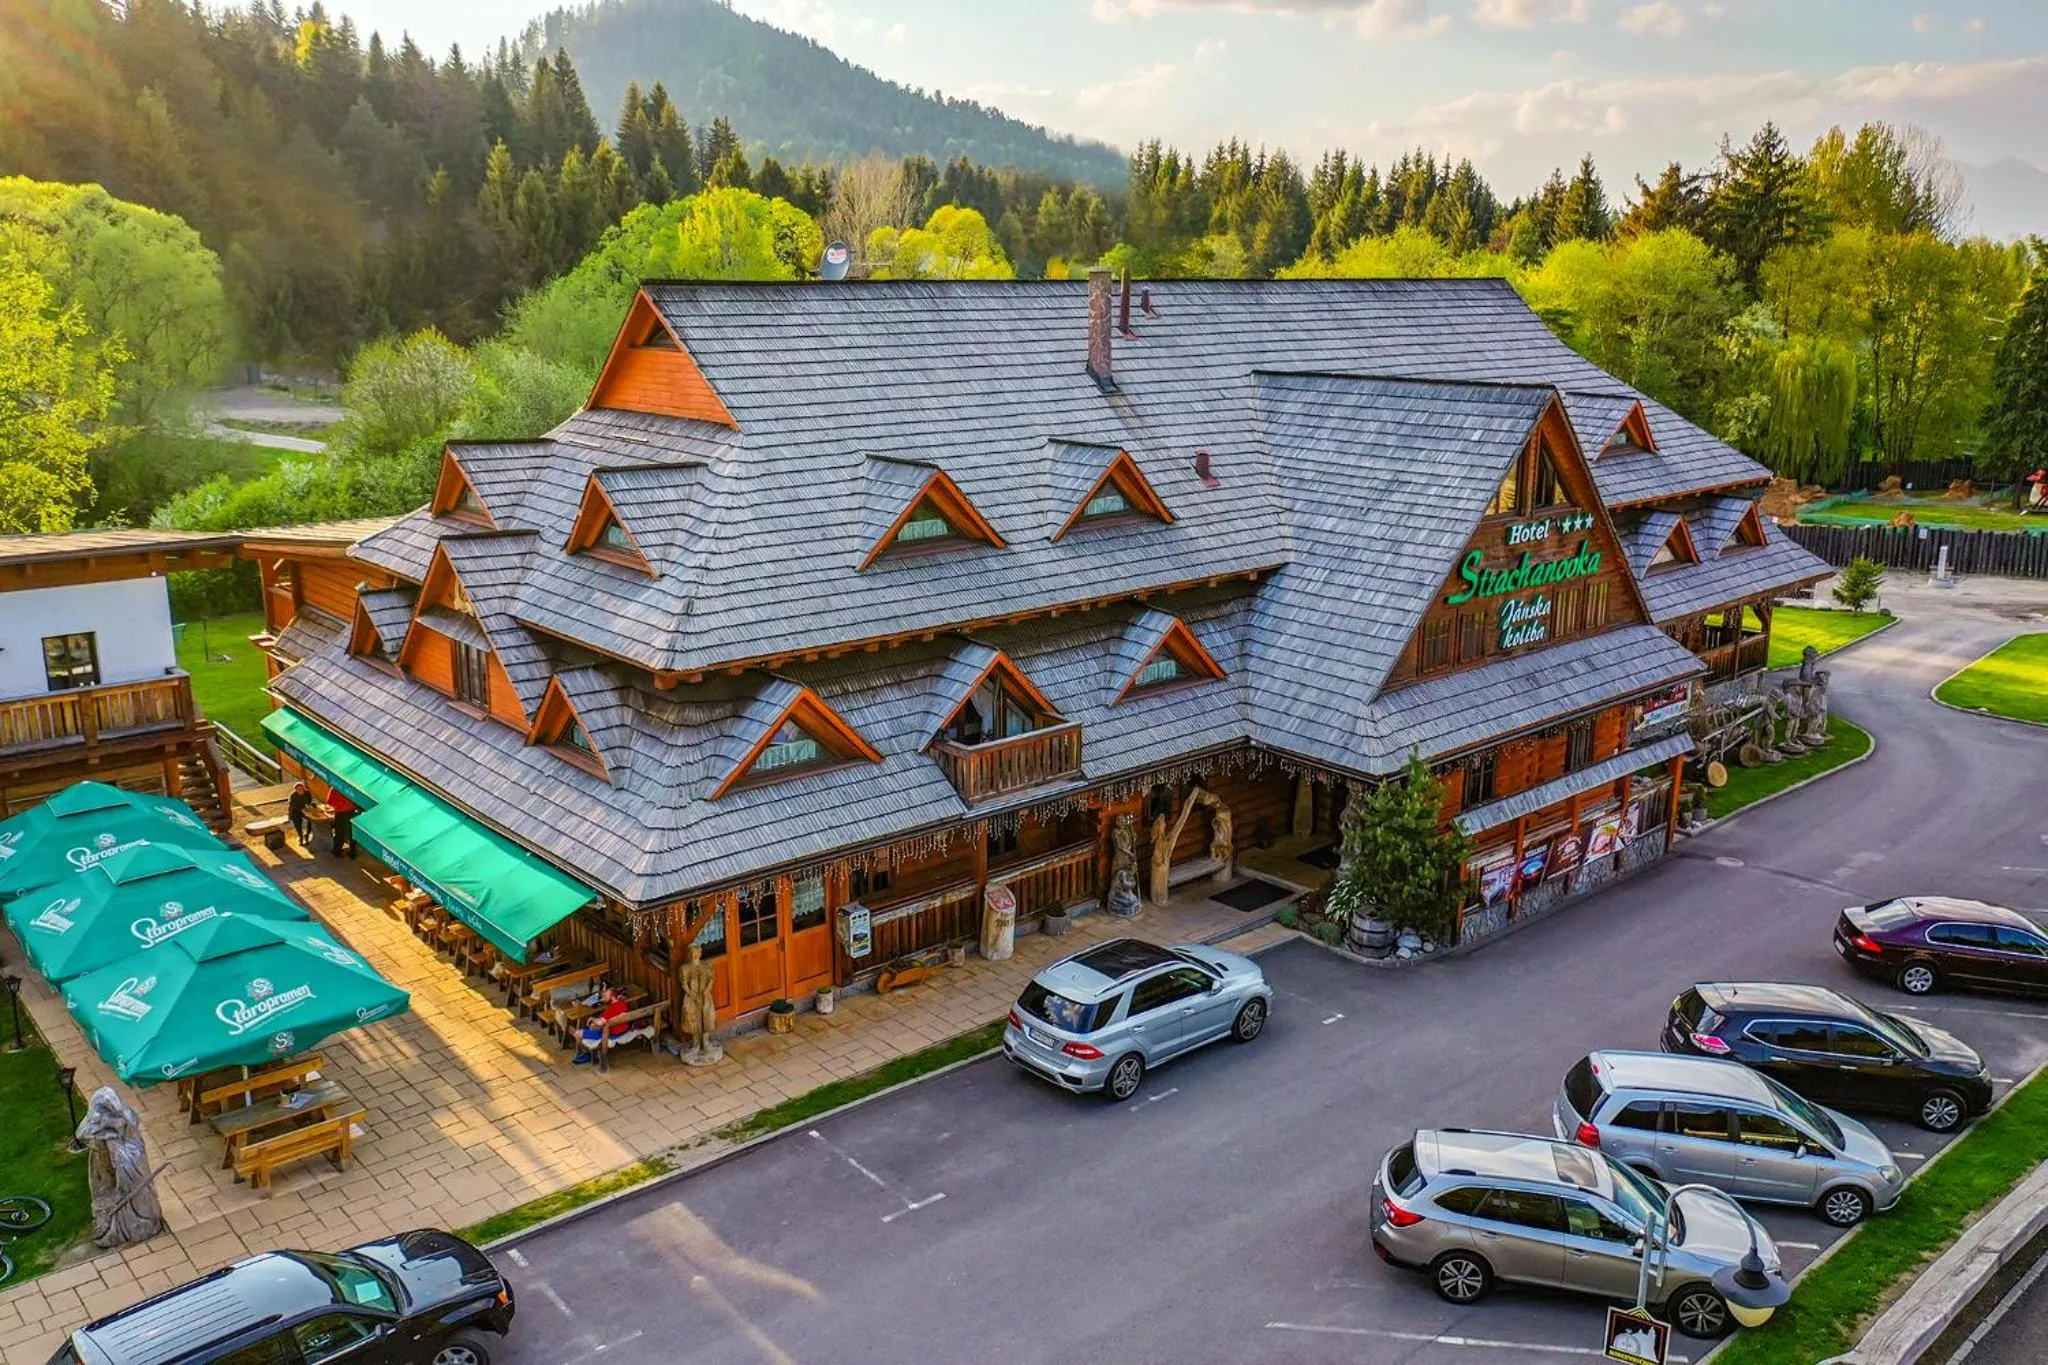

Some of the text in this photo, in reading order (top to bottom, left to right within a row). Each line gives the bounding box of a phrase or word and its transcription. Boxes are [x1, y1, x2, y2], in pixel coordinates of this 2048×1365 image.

[1509, 520, 1550, 544] Hotel
[1501, 595, 1552, 630] Jánska
[1503, 620, 1545, 649] koliba
[131, 906, 218, 949] Staropramen
[216, 984, 317, 1036] Staropramen
